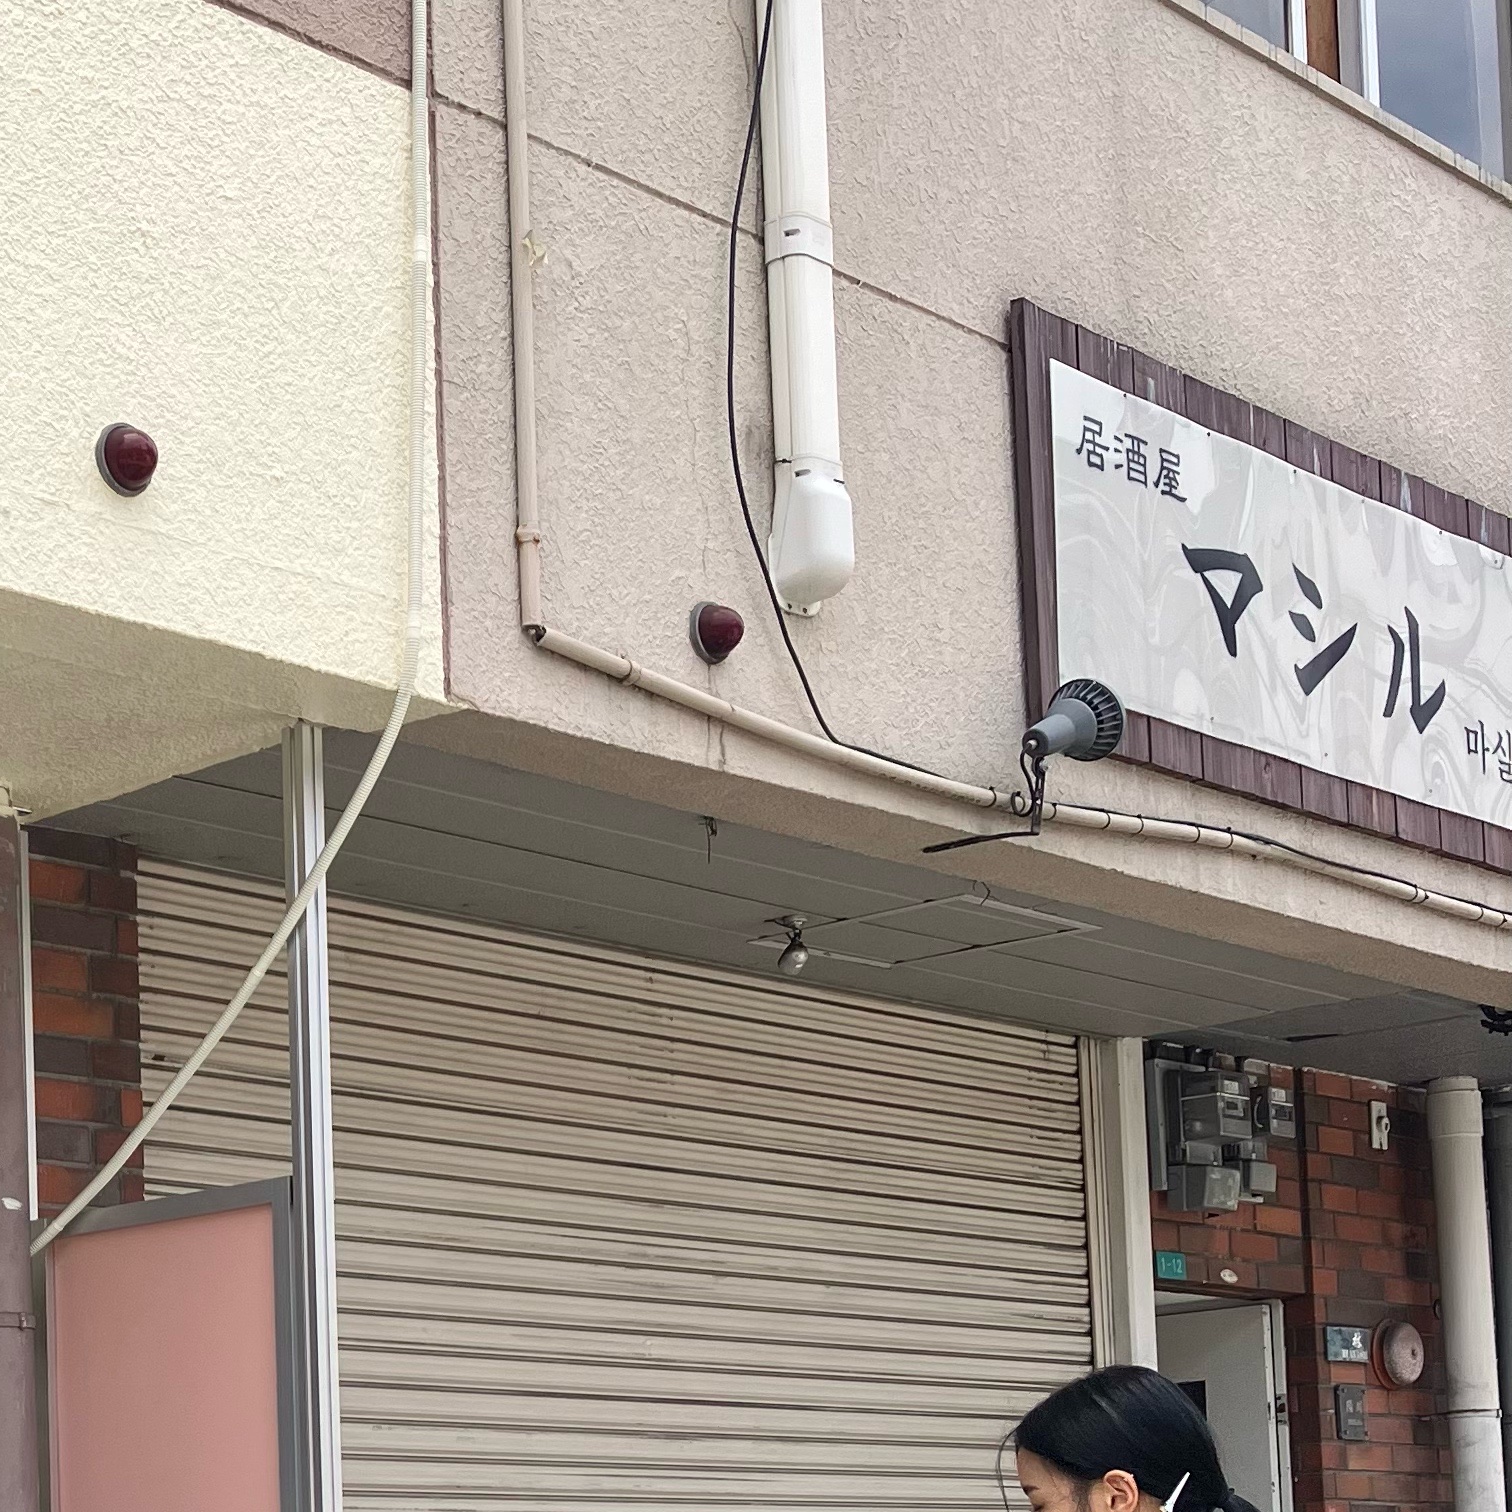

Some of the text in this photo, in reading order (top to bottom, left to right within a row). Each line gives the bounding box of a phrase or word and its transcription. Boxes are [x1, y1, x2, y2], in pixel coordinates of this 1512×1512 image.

[1076, 416, 1188, 503] 居酒屋
[1181, 542, 1446, 735] マシル
[1161, 1257, 1183, 1275] 1-12
